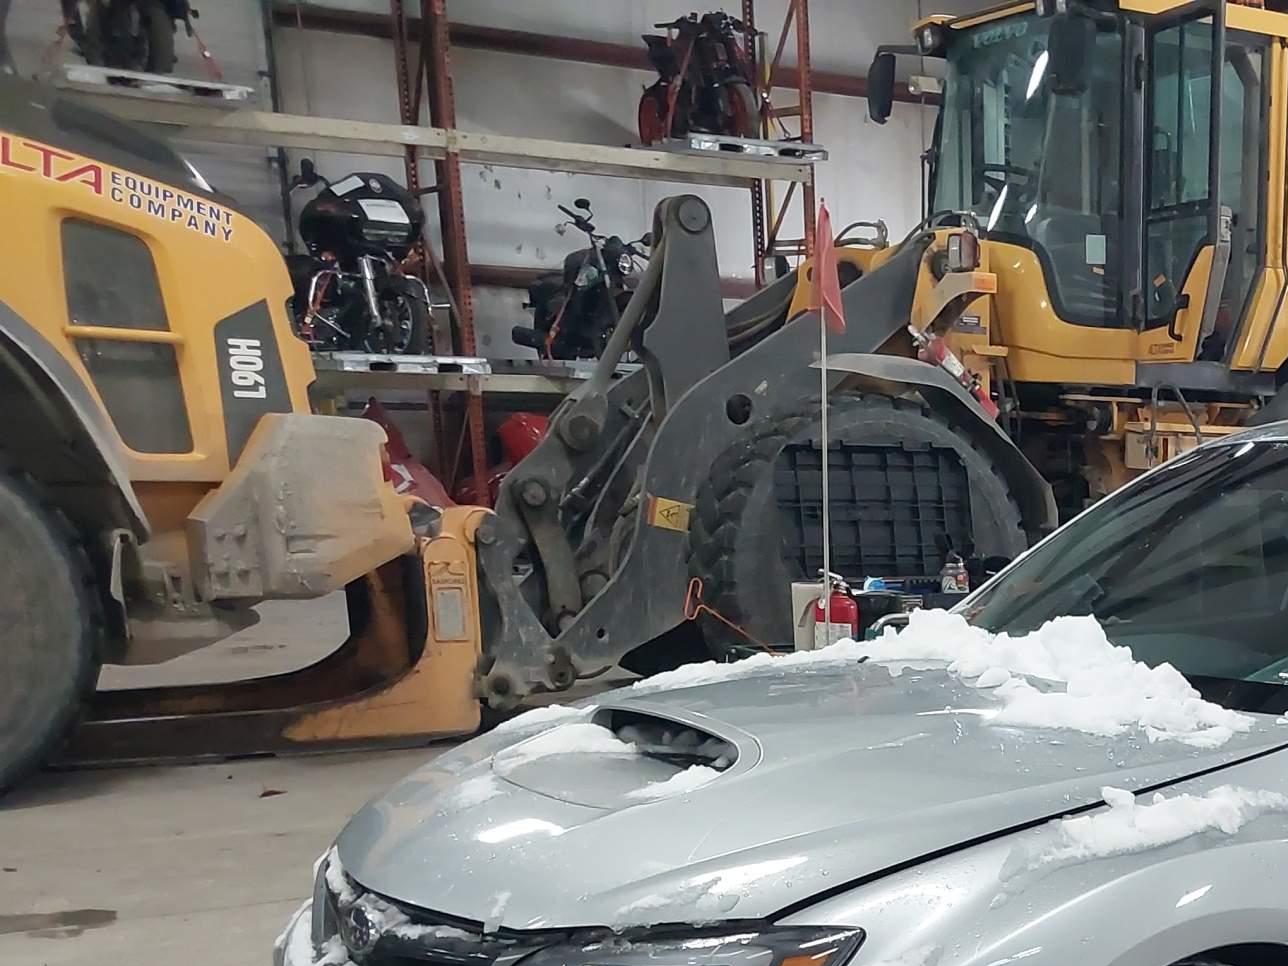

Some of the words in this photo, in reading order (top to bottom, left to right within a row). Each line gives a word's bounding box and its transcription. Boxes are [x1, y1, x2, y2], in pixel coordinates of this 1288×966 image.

[111, 171, 233, 226] EQUIPMENT
[111, 187, 233, 241] COMPANY
[227, 338, 267, 399] L90H
